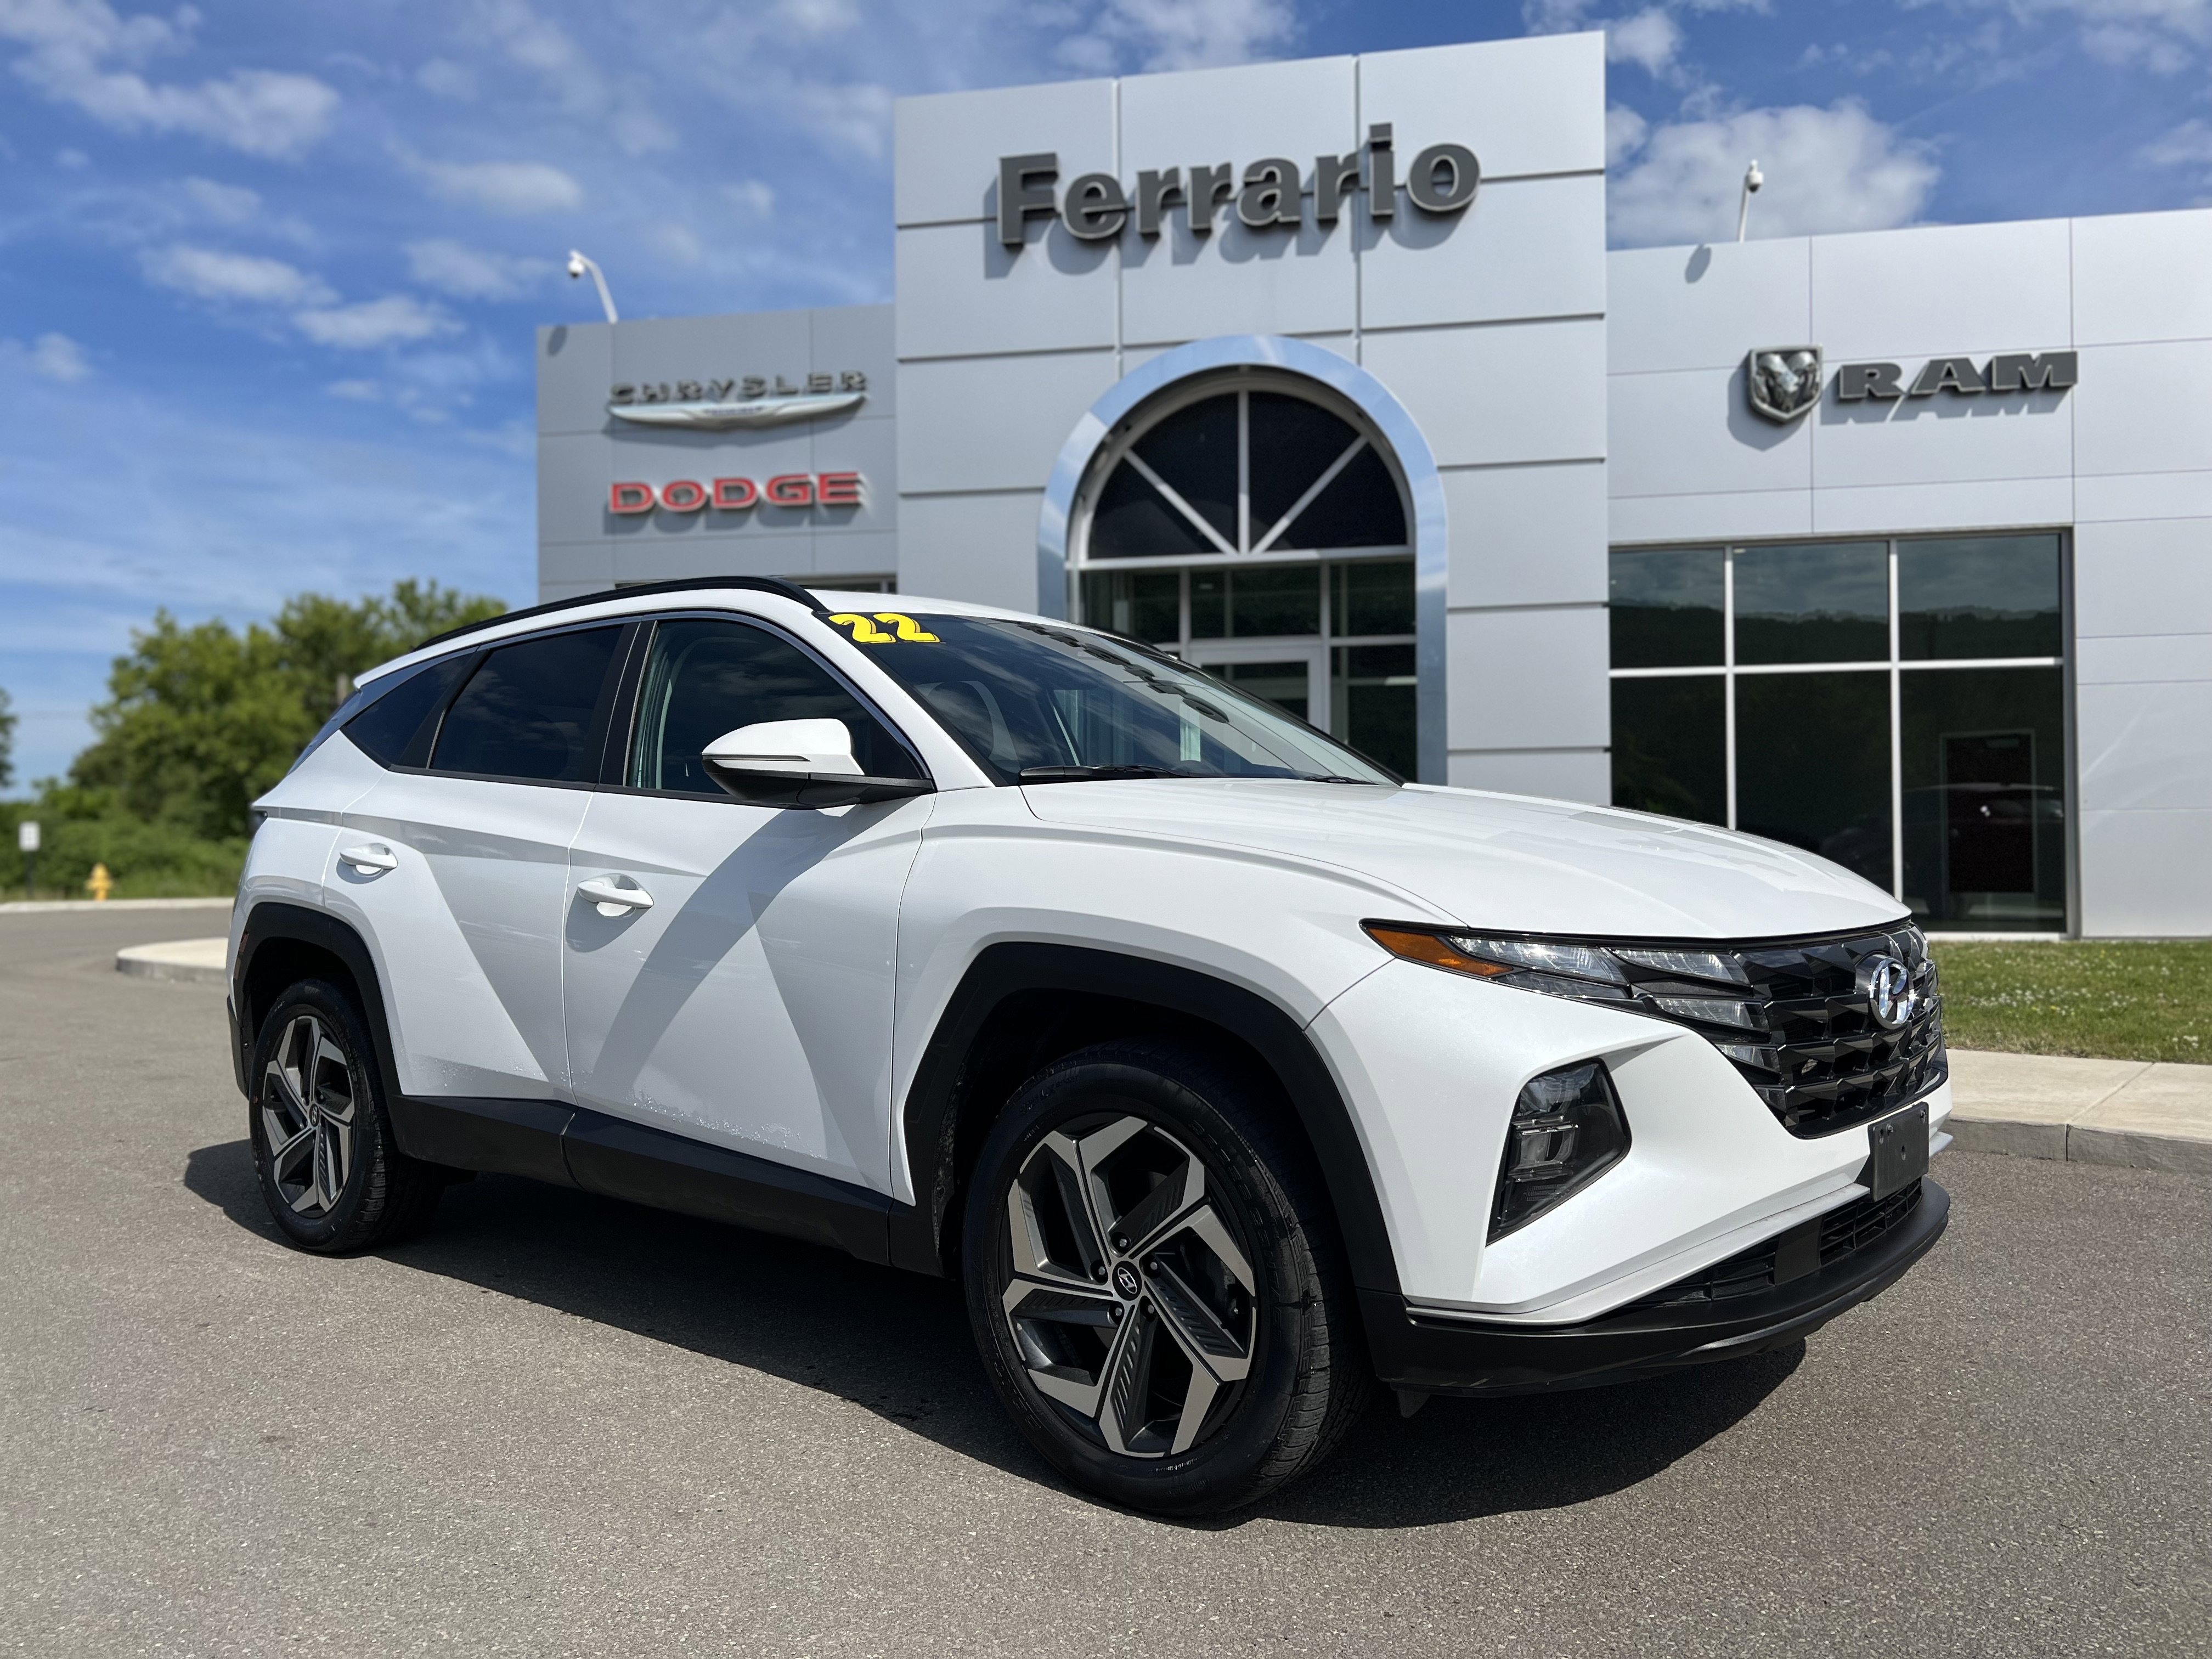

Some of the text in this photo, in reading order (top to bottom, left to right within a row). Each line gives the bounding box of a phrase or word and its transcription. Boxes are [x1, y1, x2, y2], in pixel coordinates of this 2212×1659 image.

[997, 122, 1481, 247] Ferrario
[611, 370, 867, 404] CHRYSLER
[1839, 351, 2078, 400] RAM
[610, 472, 863, 513] DODGE
[828, 613, 940, 643] 22
